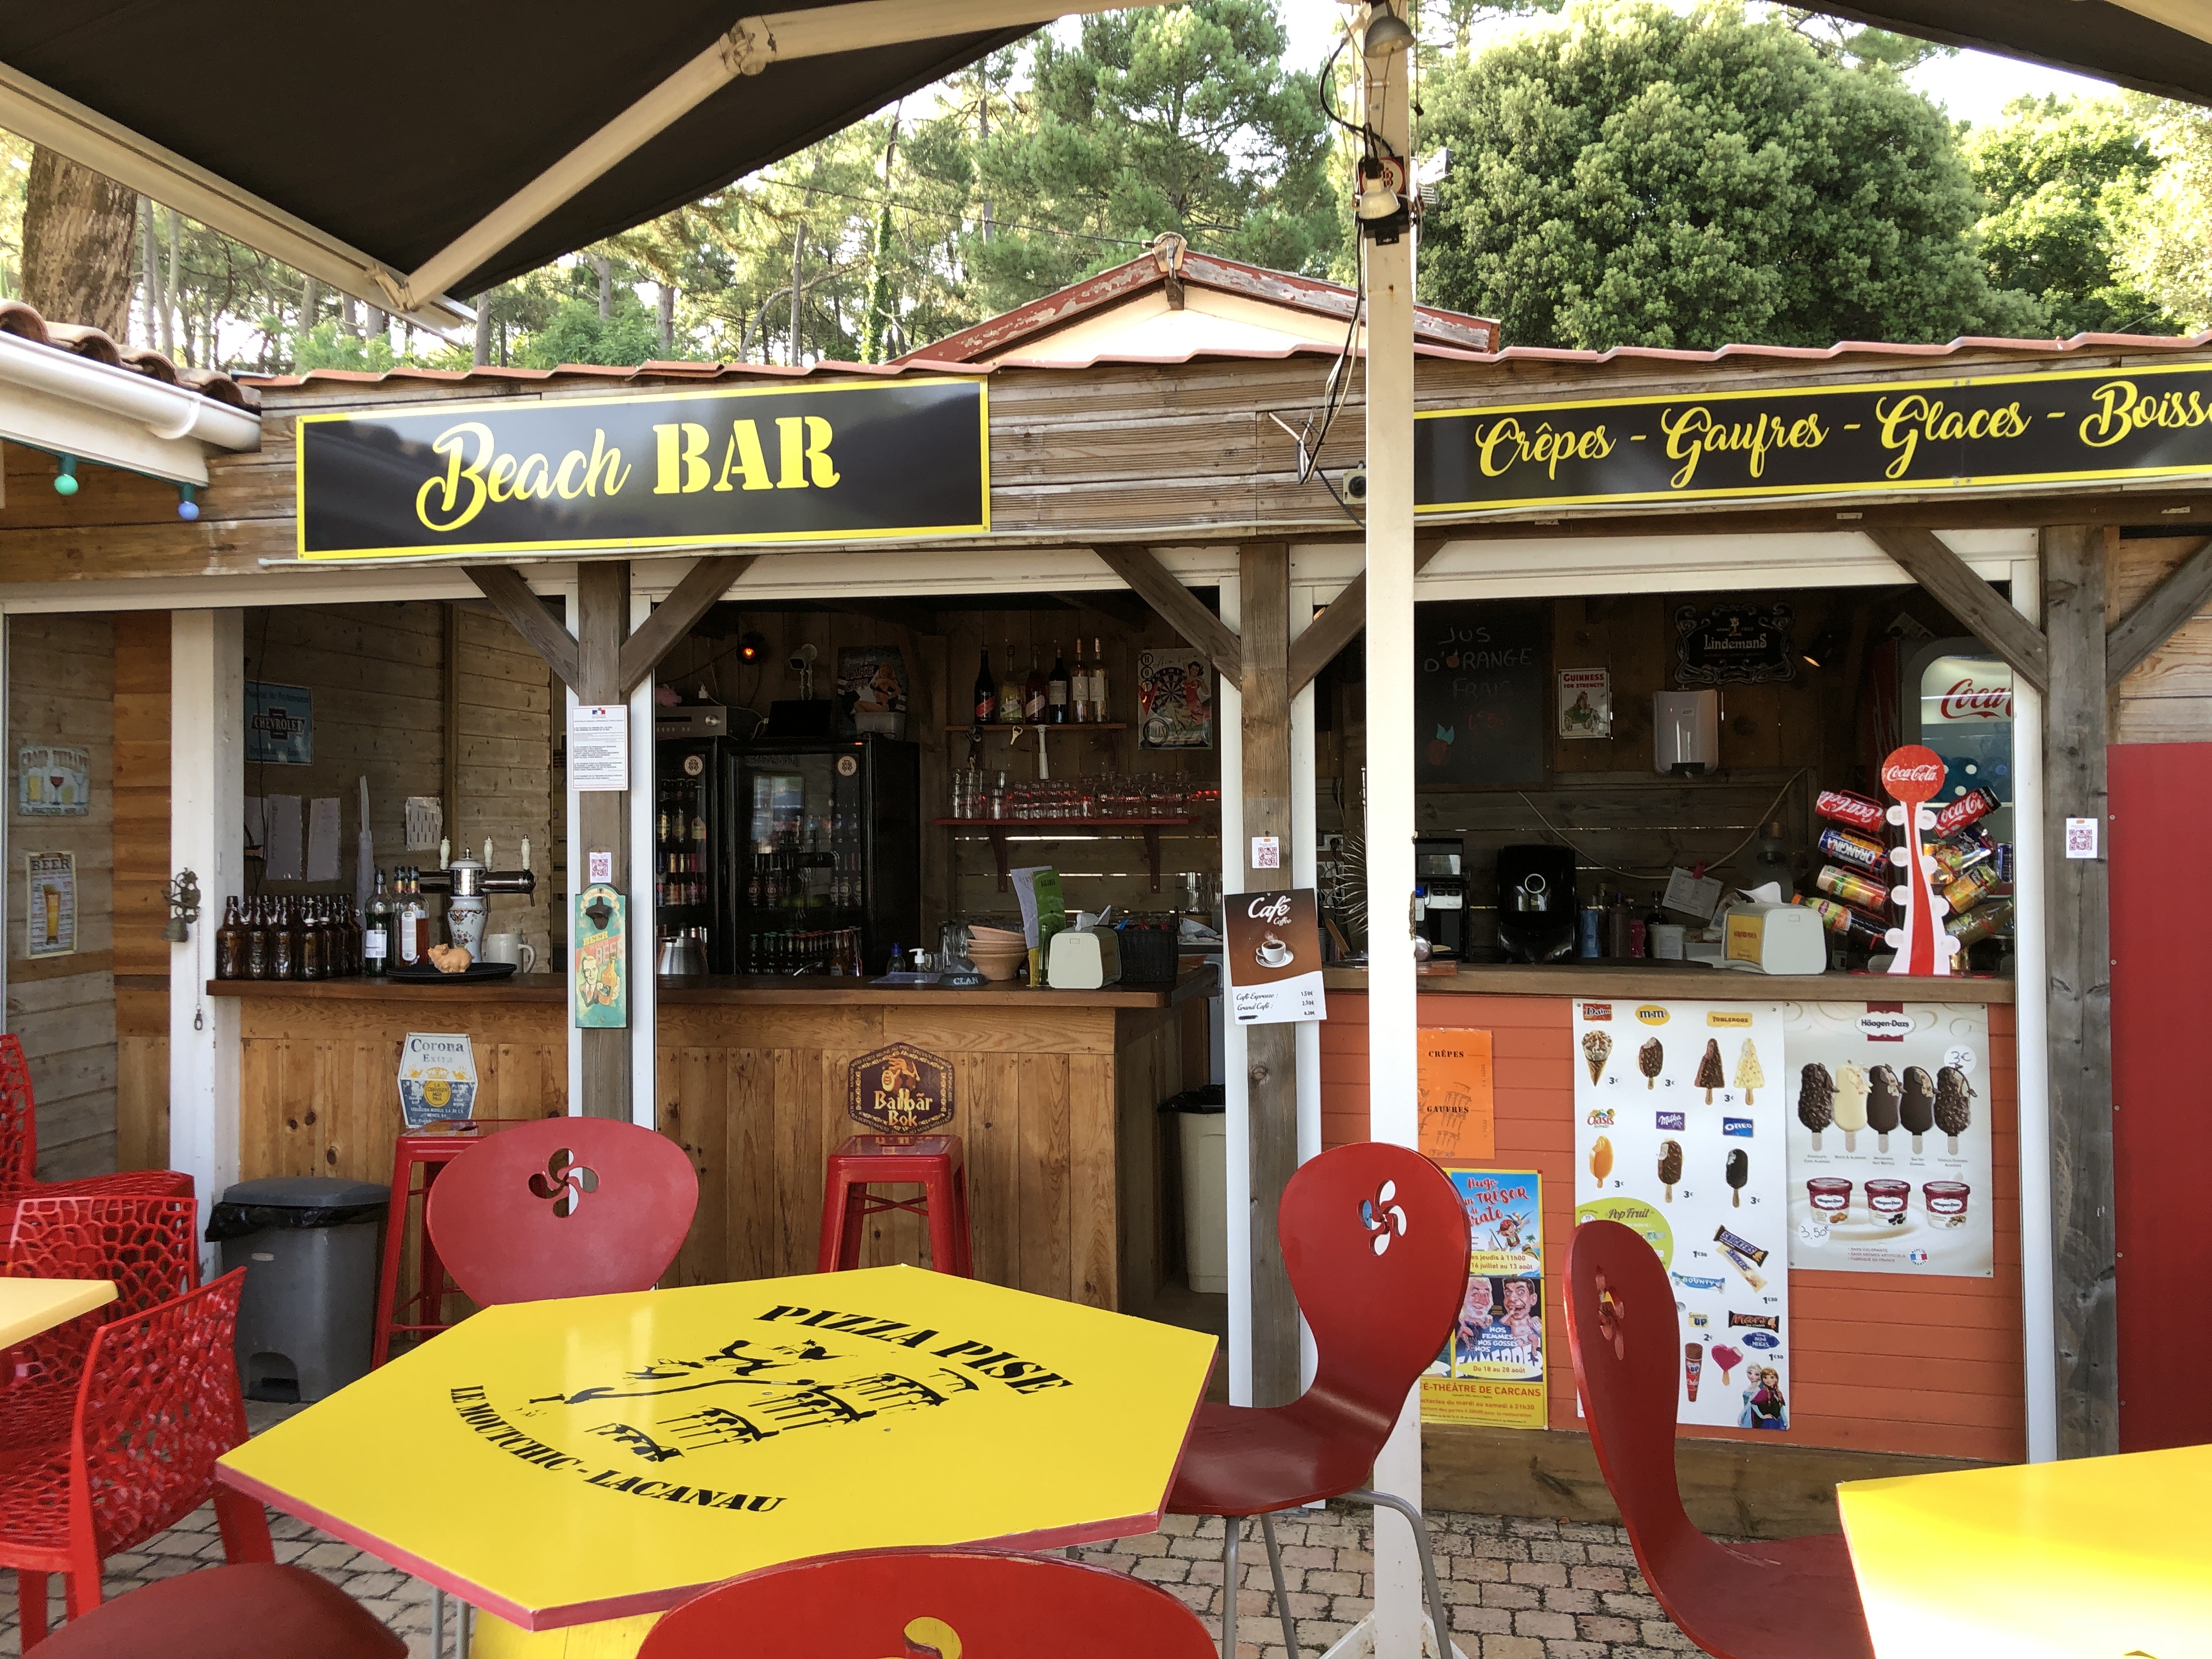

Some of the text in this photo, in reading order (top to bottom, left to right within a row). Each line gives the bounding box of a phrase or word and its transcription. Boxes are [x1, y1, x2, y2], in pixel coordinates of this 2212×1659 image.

[1476, 417, 1616, 480] Crêpes
[1661, 407, 1830, 488] Gaufres
[1875, 394, 2030, 478] Glaces
[2079, 380, 2212, 448] Boiss
[416, 416, 840, 531] Beach BAR
[1437, 627, 1491, 645] JUS
[1563, 673, 1604, 682] GUINNESS
[1940, 678, 2011, 719] Coca
[254, 716, 304, 732] CHEVROLET
[1886, 764, 1940, 782] Coca-Cola
[31, 858, 71, 871] BEER
[1248, 895, 1292, 923] Café
[1585, 1006, 1610, 1015] Daim
[1861, 1019, 1910, 1029] Häagen-Dazs
[411, 1038, 464, 1053] Corona
[1428, 1049, 1464, 1058] CRÊPES
[1426, 1105, 1469, 1114] GAUFRES
[887, 1110, 918, 1127] Bok
[1587, 1115, 1615, 1126] Oasis
[1658, 1113, 1683, 1126] Milka
[1724, 1122, 1752, 1131] OREO
[1467, 1177, 1498, 1190] Hugo
[1474, 1186, 1530, 1205] TRÉSOR
[1608, 1208, 1626, 1221] Pop
[1626, 1207, 1650, 1219] Fruit
[1720, 1232, 1757, 1254] SNICKERS
[1683, 1276, 1716, 1286] BOUNTY
[753, 1304, 1075, 1396] PIZZA PISE
[1479, 1385, 1492, 1394] DE
[1494, 1386, 1541, 1397] CARCANS
[450, 1384, 484, 1403] LE
[584, 1467, 788, 1513] LACANAU
